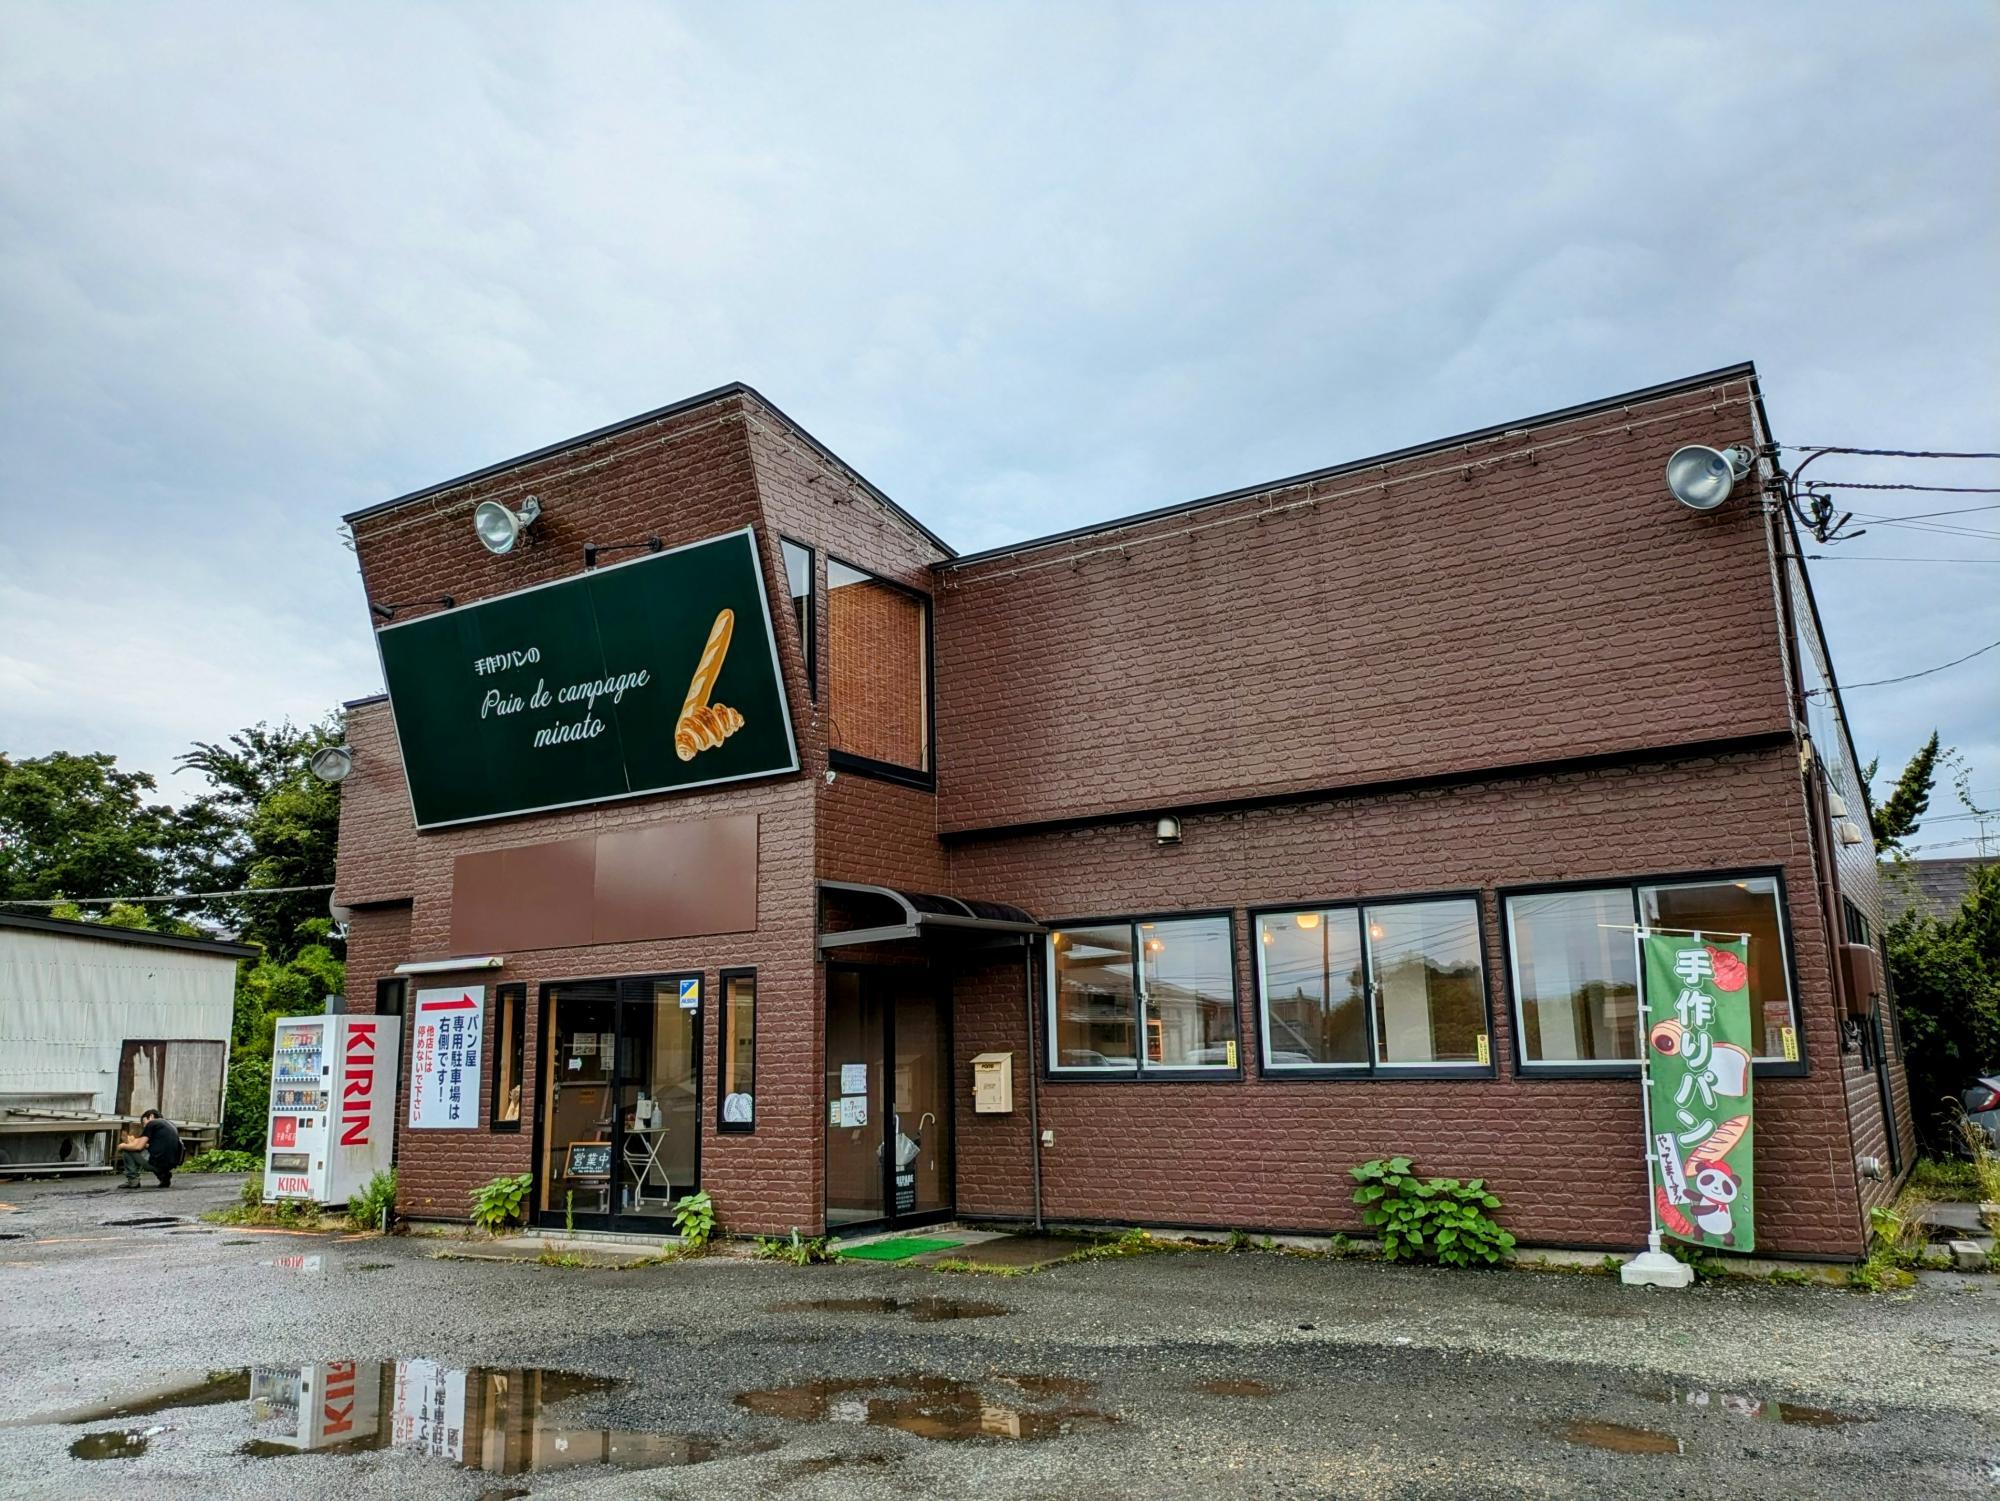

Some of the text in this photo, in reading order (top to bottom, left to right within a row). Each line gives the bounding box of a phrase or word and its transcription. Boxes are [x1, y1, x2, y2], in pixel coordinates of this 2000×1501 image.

[474, 647, 541, 676] 手作りパンの
[481, 669, 650, 719] Pain de campagne
[533, 712, 606, 748] minato
[424, 1025, 435, 1073] 他店には
[437, 1016, 451, 1103] 右側です!
[465, 1014, 480, 1067] パン屋
[1673, 948, 1718, 1148] 手作りパン
[340, 1024, 376, 1145] KIRIN
[413, 1025, 426, 1122] 停めないで下さい
[448, 1015, 465, 1120] 専用駐車場は
[574, 1152, 609, 1166] 営業中
[278, 1177, 309, 1193] KIRIN
